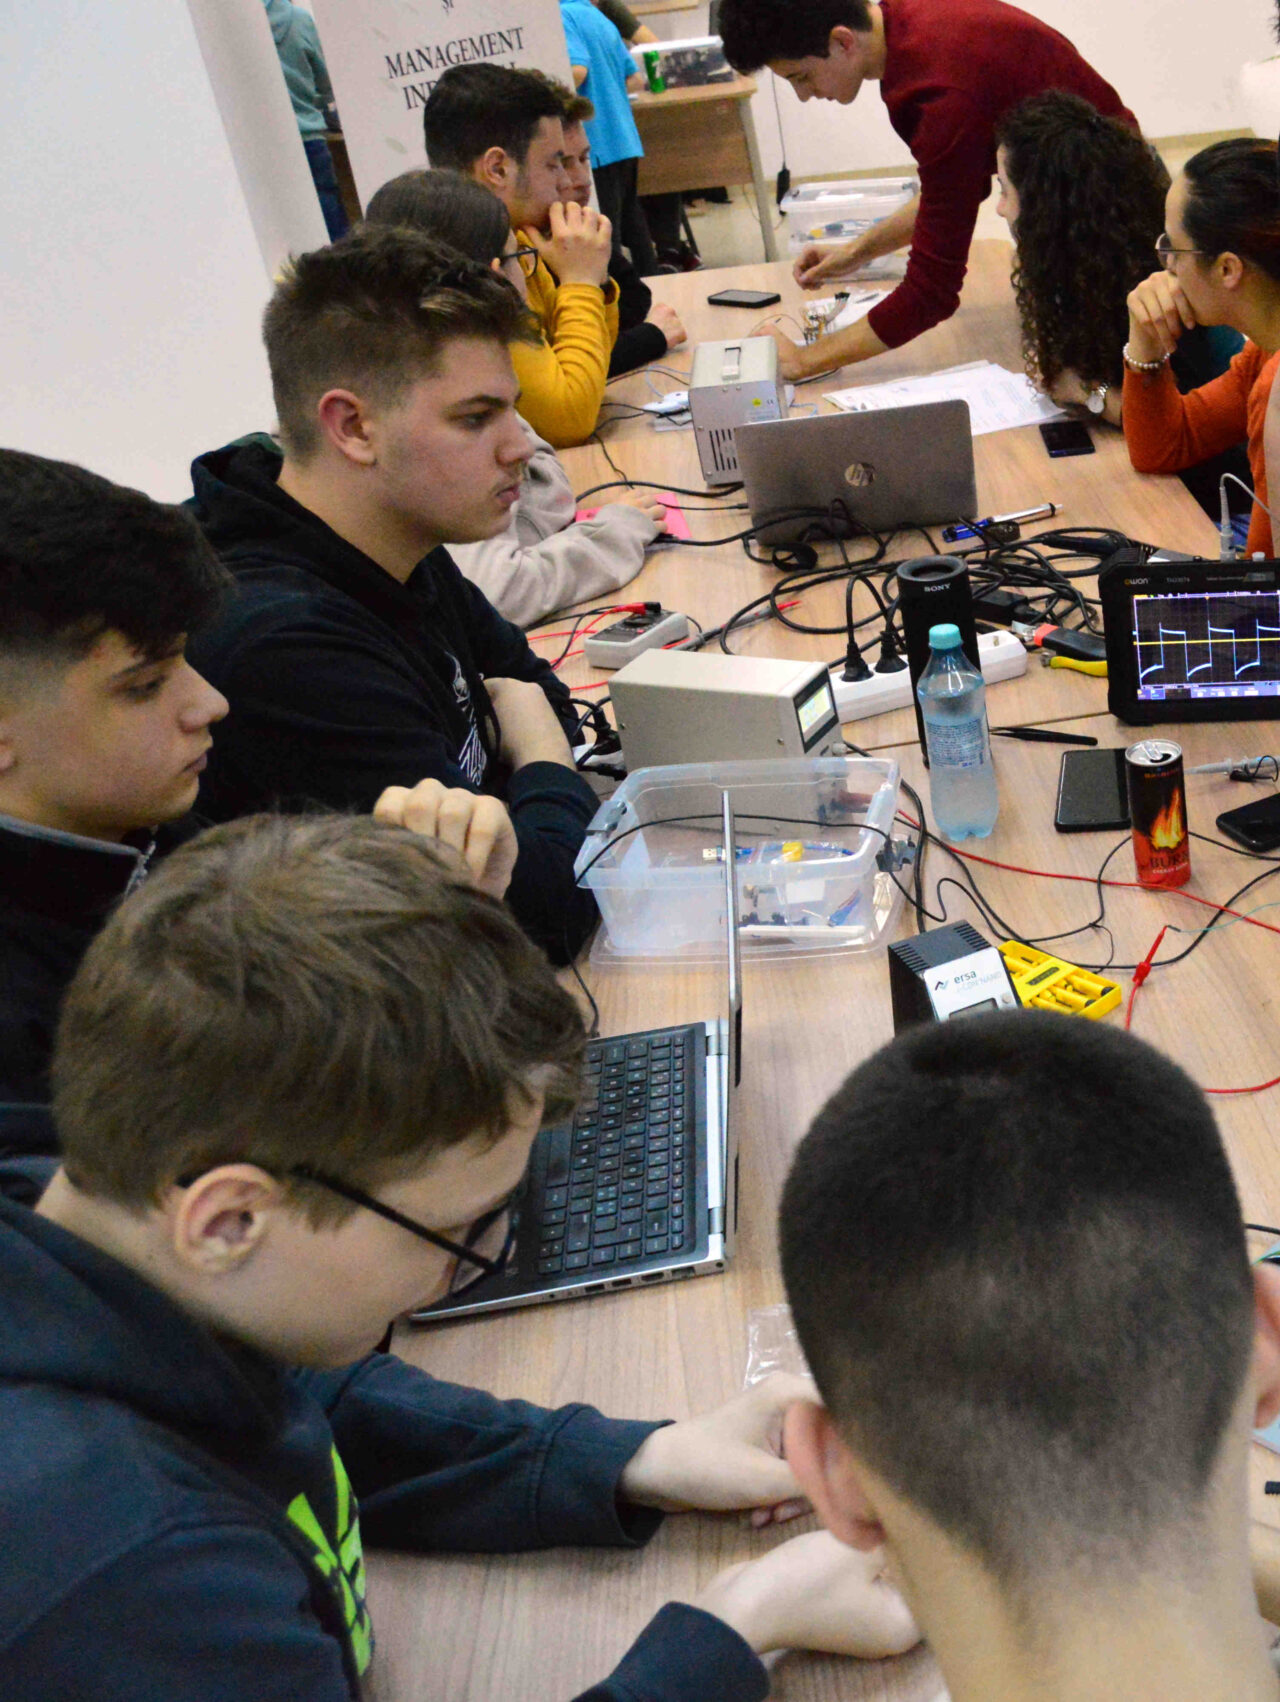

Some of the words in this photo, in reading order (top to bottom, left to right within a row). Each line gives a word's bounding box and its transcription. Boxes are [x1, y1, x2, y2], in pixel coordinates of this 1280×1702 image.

[384, 27, 525, 79] MANAGEMENT
[923, 584, 951, 593] SONY
[953, 969, 977, 985] ersa
